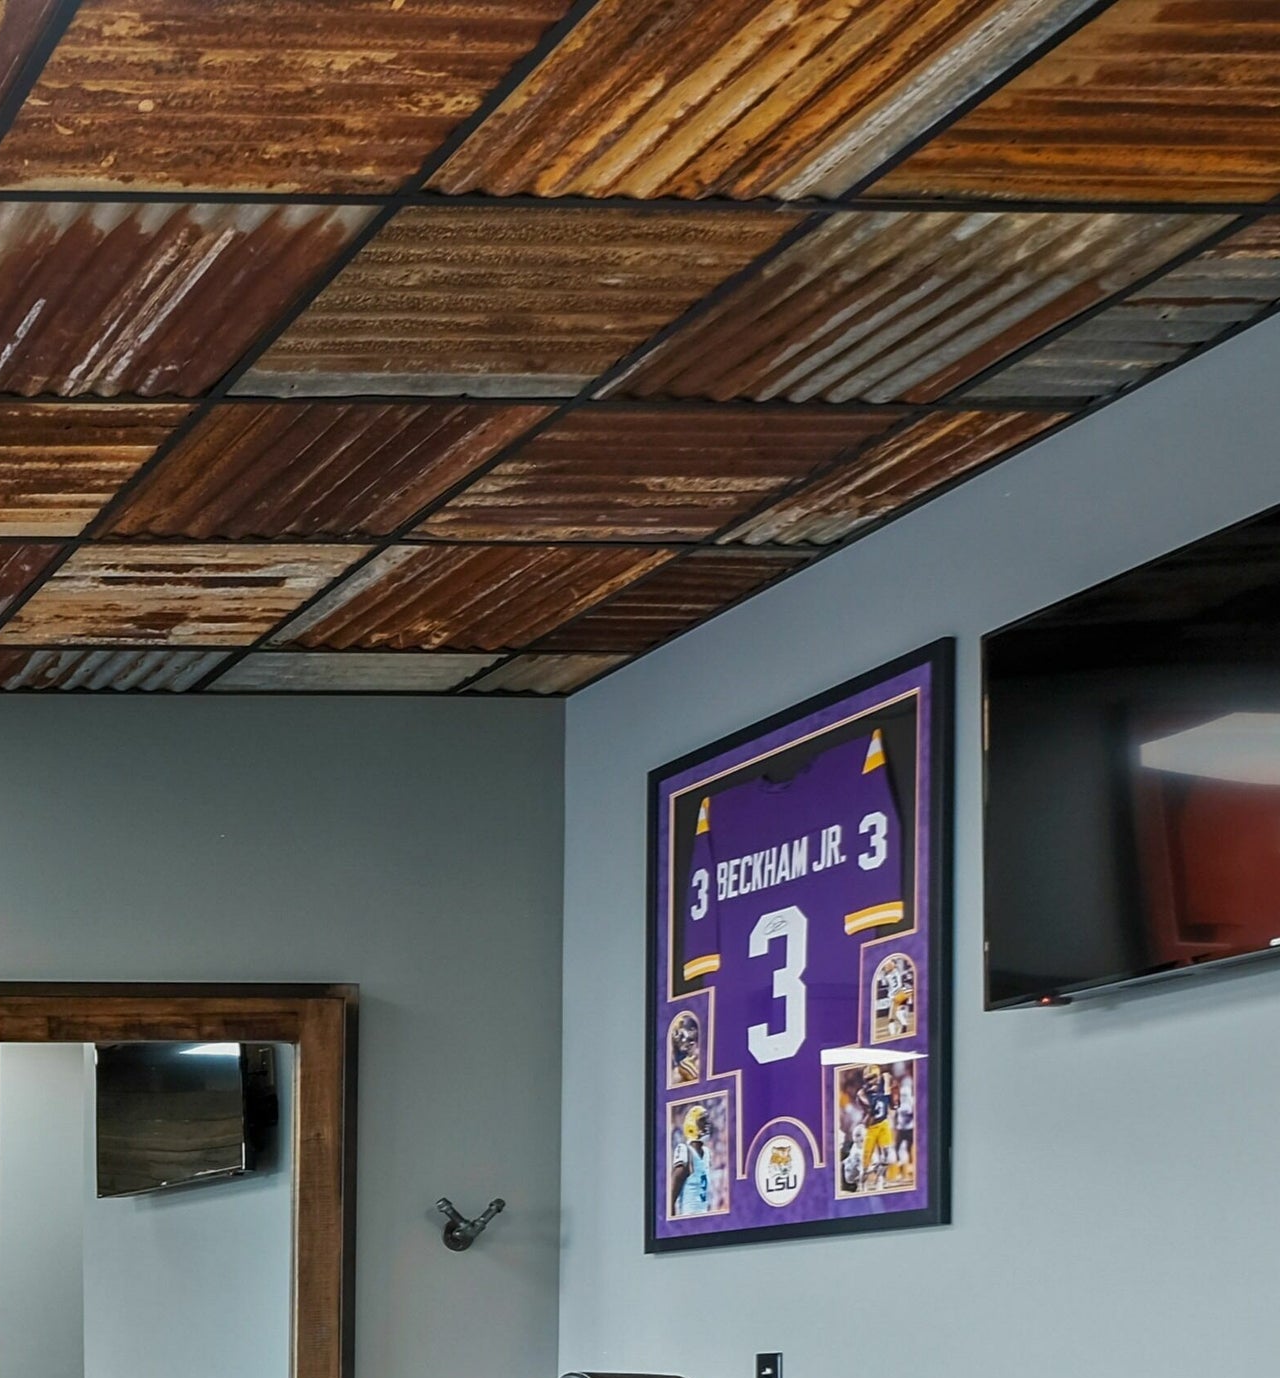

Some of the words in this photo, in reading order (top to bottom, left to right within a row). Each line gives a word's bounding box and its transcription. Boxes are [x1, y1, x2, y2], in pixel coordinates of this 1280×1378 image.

[717, 836, 808, 901] BECKHAM
[812, 824, 847, 872] JR.
[858, 811, 887, 871] 3
[691, 868, 709, 920] 3
[748, 905, 807, 1065] 3
[766, 1174, 798, 1192] LSU
